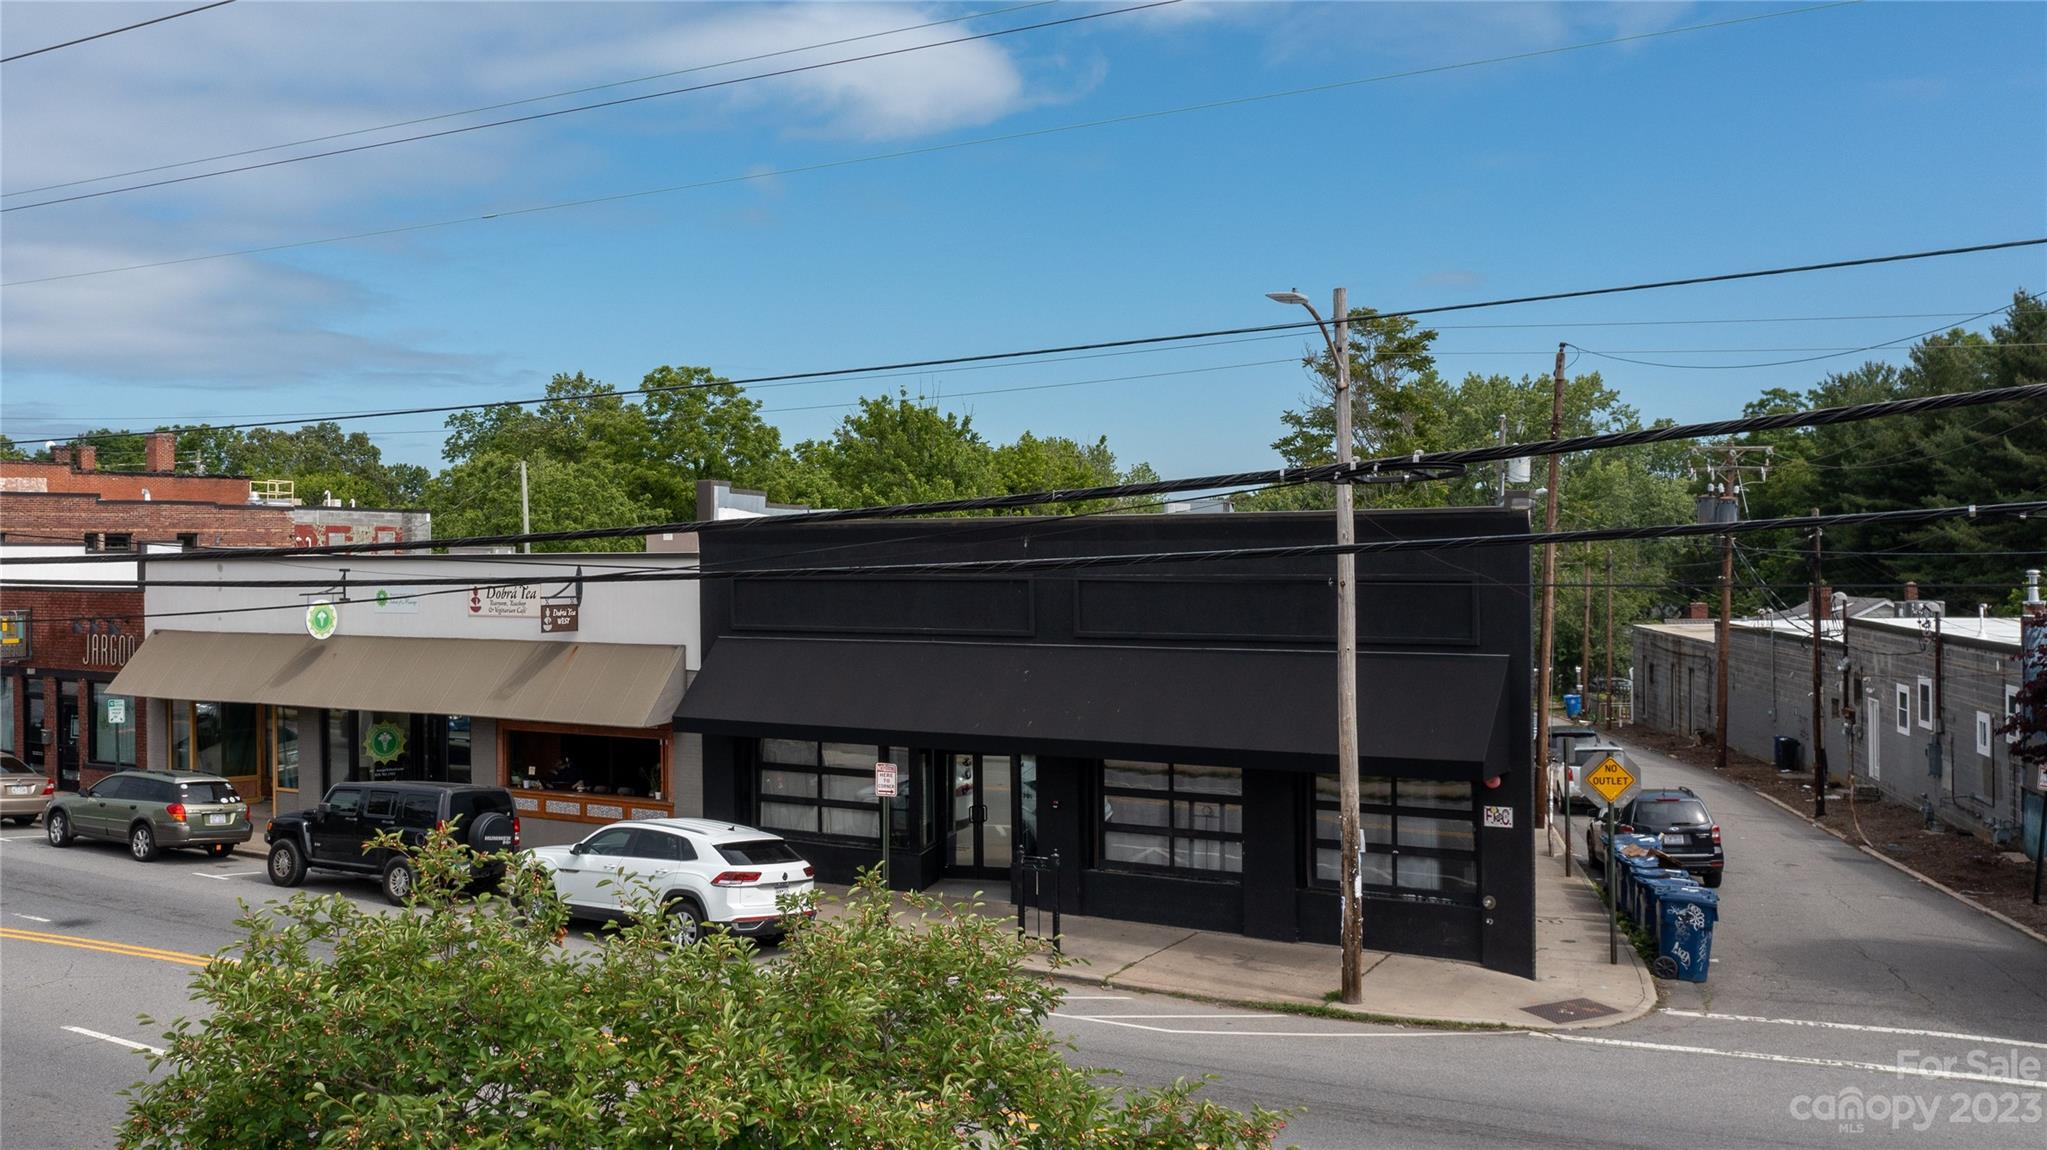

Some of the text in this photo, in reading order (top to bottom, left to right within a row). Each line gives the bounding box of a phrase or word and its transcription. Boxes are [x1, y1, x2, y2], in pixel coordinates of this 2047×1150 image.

[519, 585, 537, 600] Tea
[567, 608, 577, 616] Tea
[557, 617, 571, 625] WEST
[1604, 764, 1618, 773] NO
[1592, 776, 1629, 786] OUTLET
